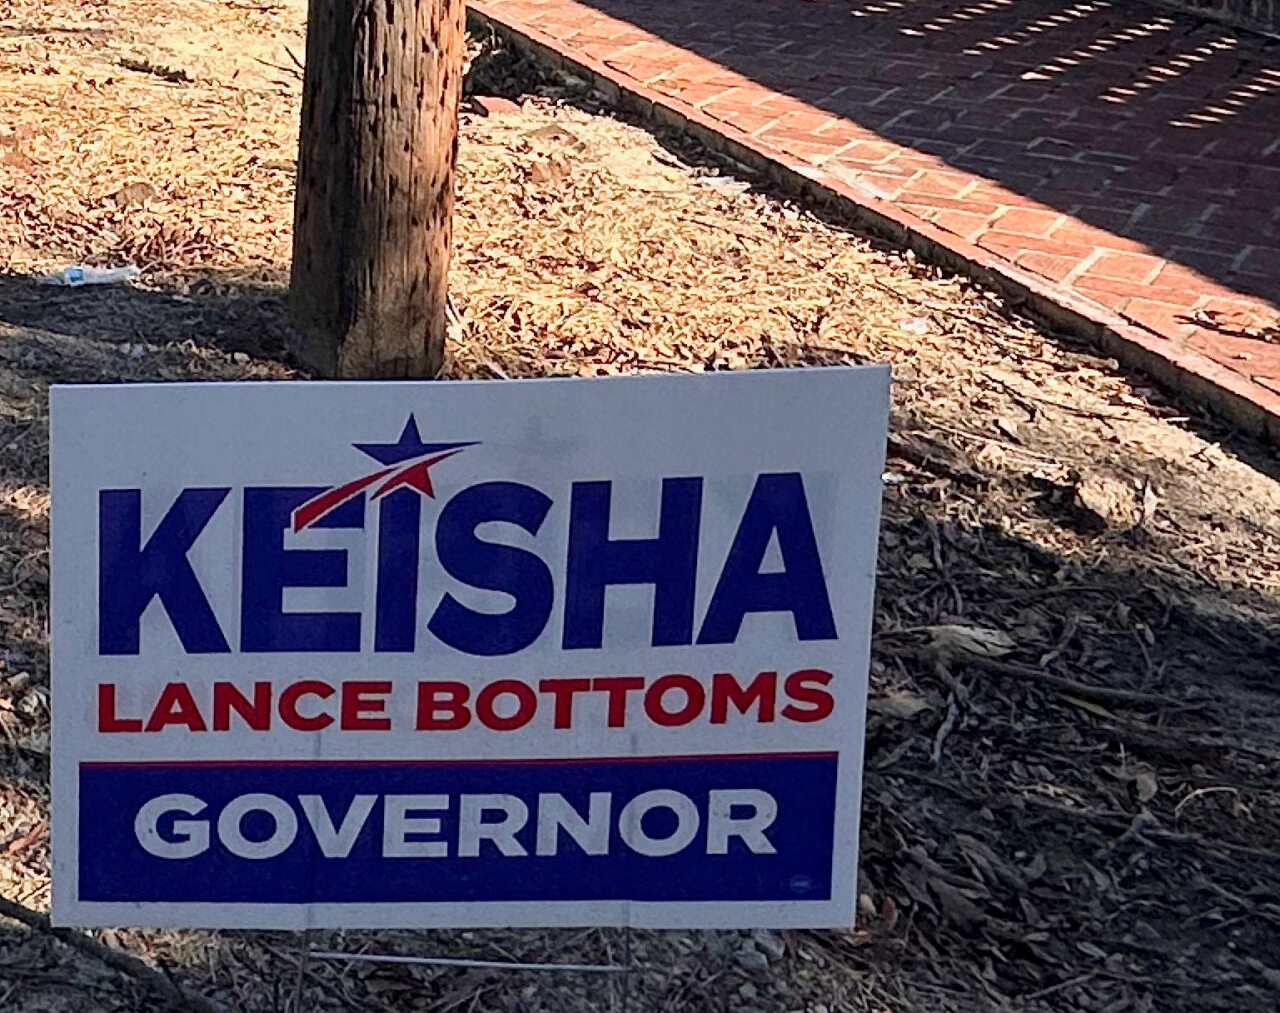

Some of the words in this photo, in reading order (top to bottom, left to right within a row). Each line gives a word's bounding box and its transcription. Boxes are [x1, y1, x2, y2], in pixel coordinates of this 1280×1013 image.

[98, 472, 839, 657] KEISHA
[97, 679, 392, 733] LANCE
[415, 670, 835, 731] BOTTOMS
[133, 788, 778, 860] GOVERNOR
